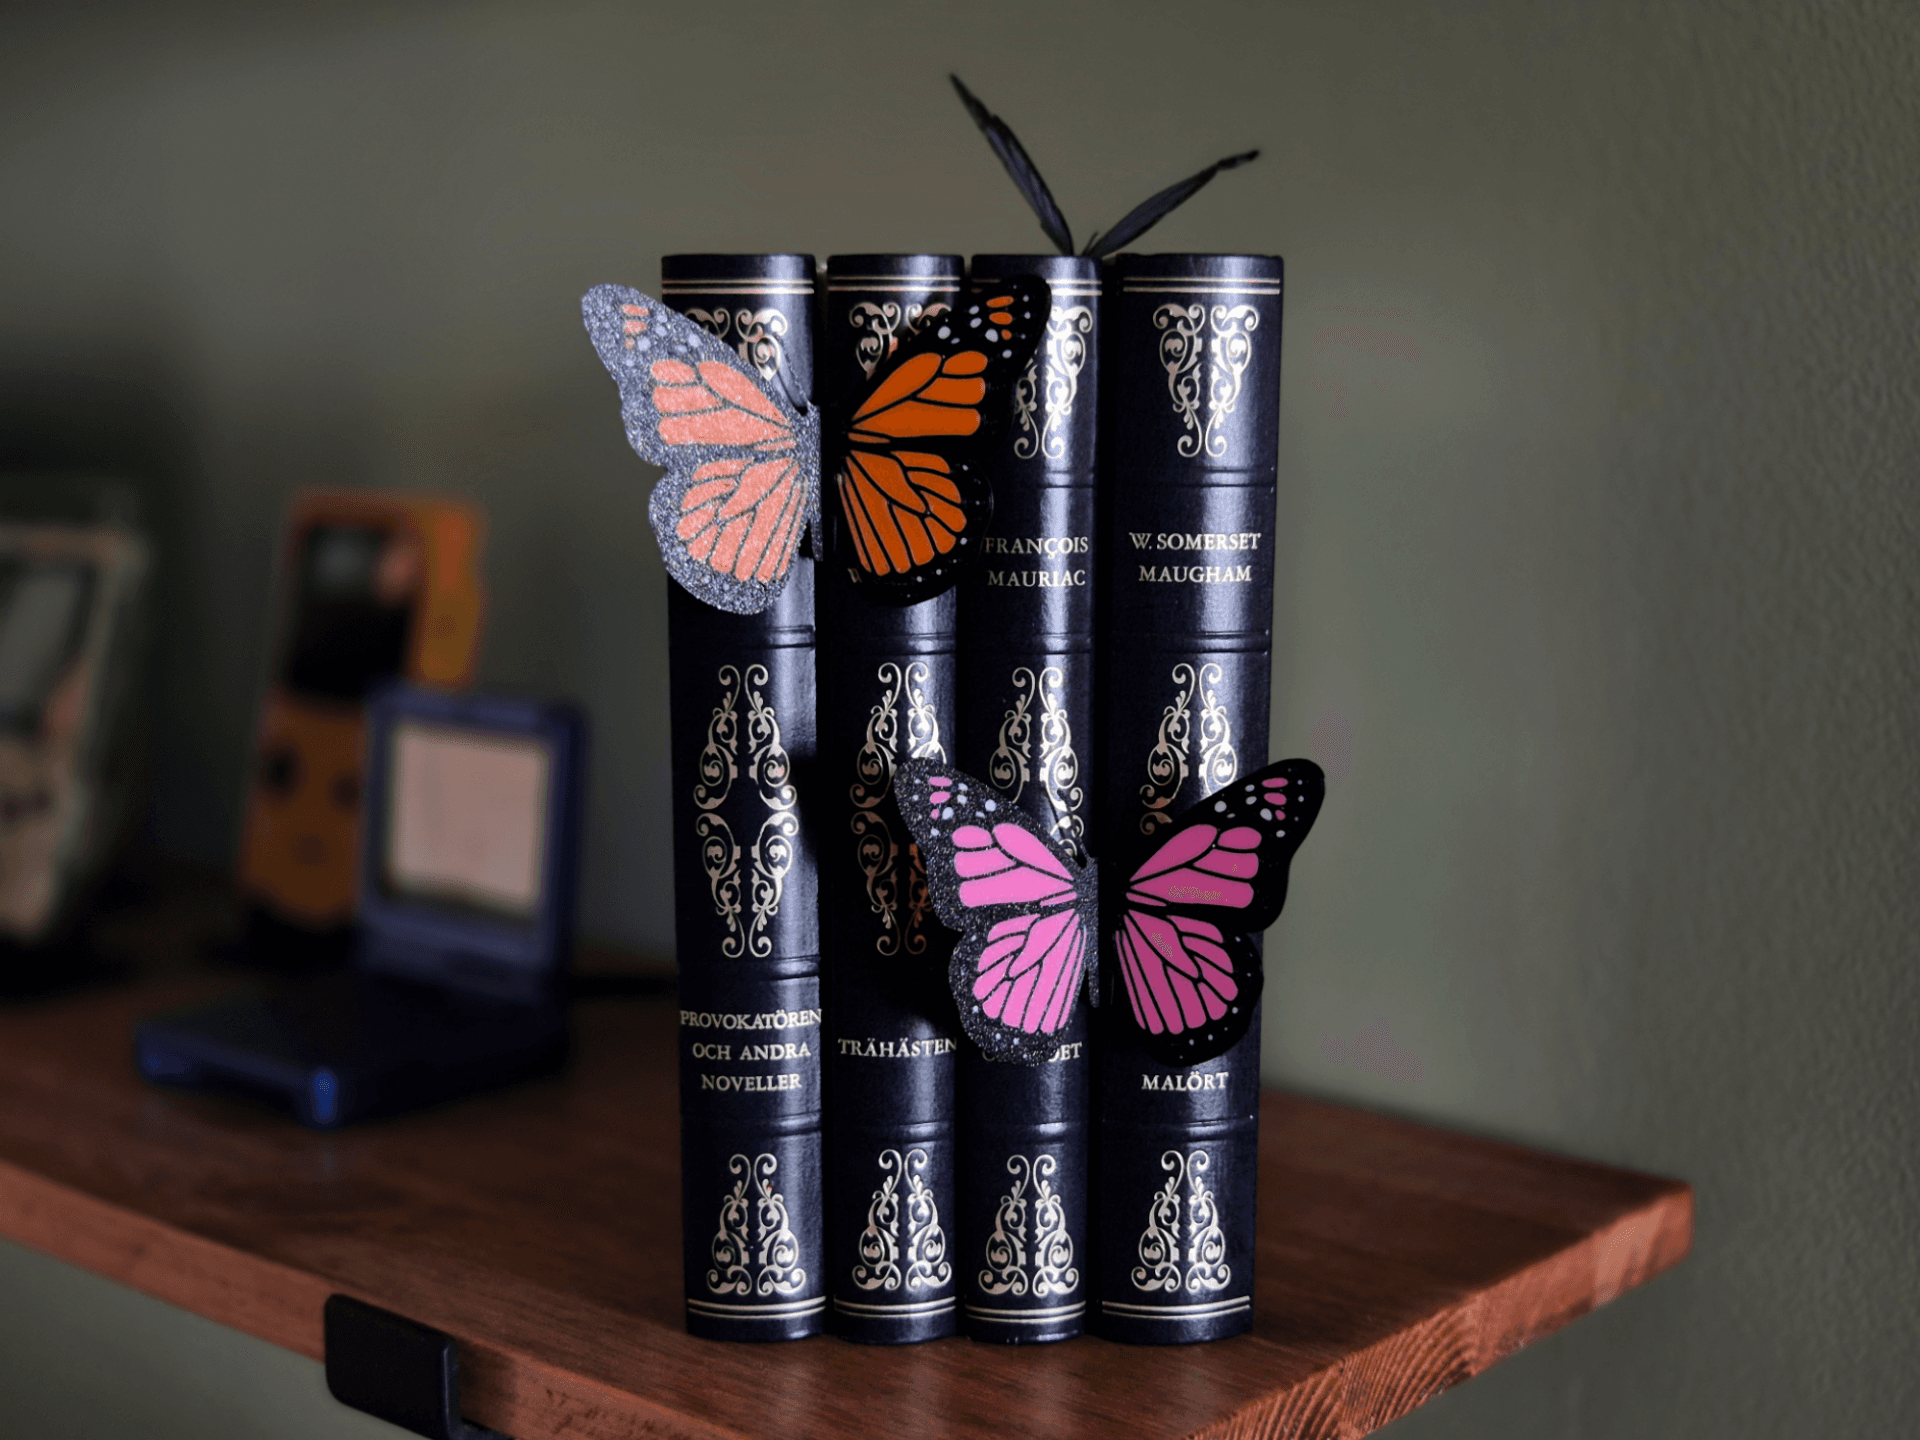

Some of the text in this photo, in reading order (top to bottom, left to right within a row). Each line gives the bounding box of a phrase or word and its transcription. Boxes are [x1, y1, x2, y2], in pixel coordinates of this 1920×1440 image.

[985, 535, 1089, 560] FRANÇOIS
[1129, 532, 1261, 551] W. SOMERSET
[987, 569, 1086, 588] MAURIAC
[1138, 565, 1252, 583] MAUGHAM
[680, 1009, 822, 1030] PROVOKATÖREN
[692, 1042, 811, 1061] OCH ANDRA
[838, 1037, 957, 1058] TRÄHÄSTEN
[701, 1073, 801, 1092] NOVELLER
[1141, 1072, 1229, 1092] MALÖRT
